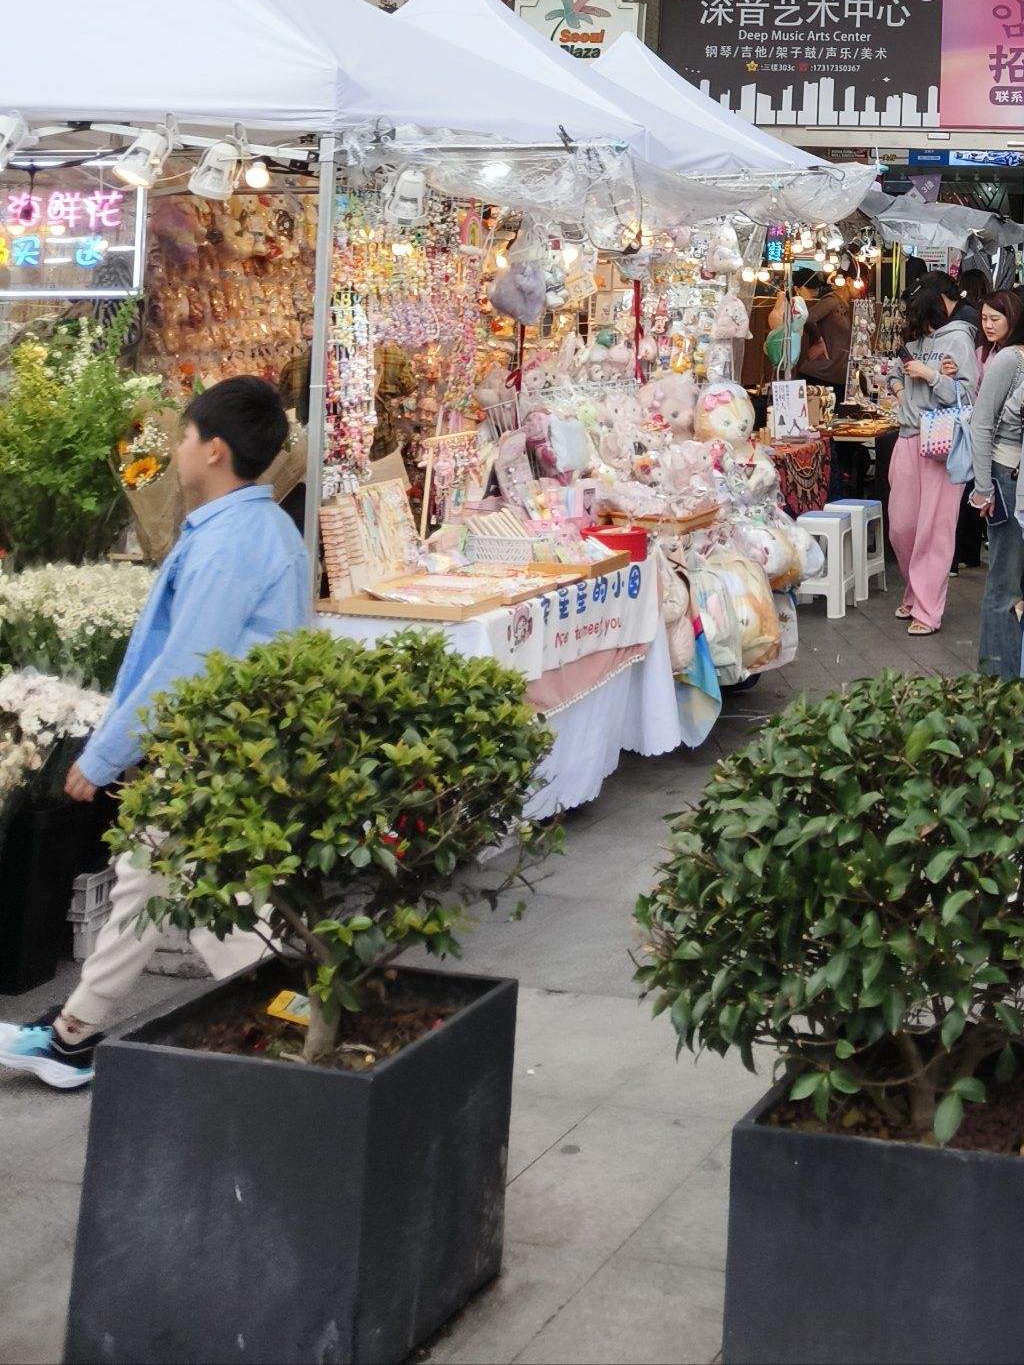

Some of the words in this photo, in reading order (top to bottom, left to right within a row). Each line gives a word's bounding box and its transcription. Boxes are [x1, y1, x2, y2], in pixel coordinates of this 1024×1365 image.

[559, 28, 605, 43] Seoul
[738, 29, 768, 42] Deep
[772, 30, 804, 41] Music
[807, 31, 830, 42] Arts
[833, 31, 872, 42] Center
